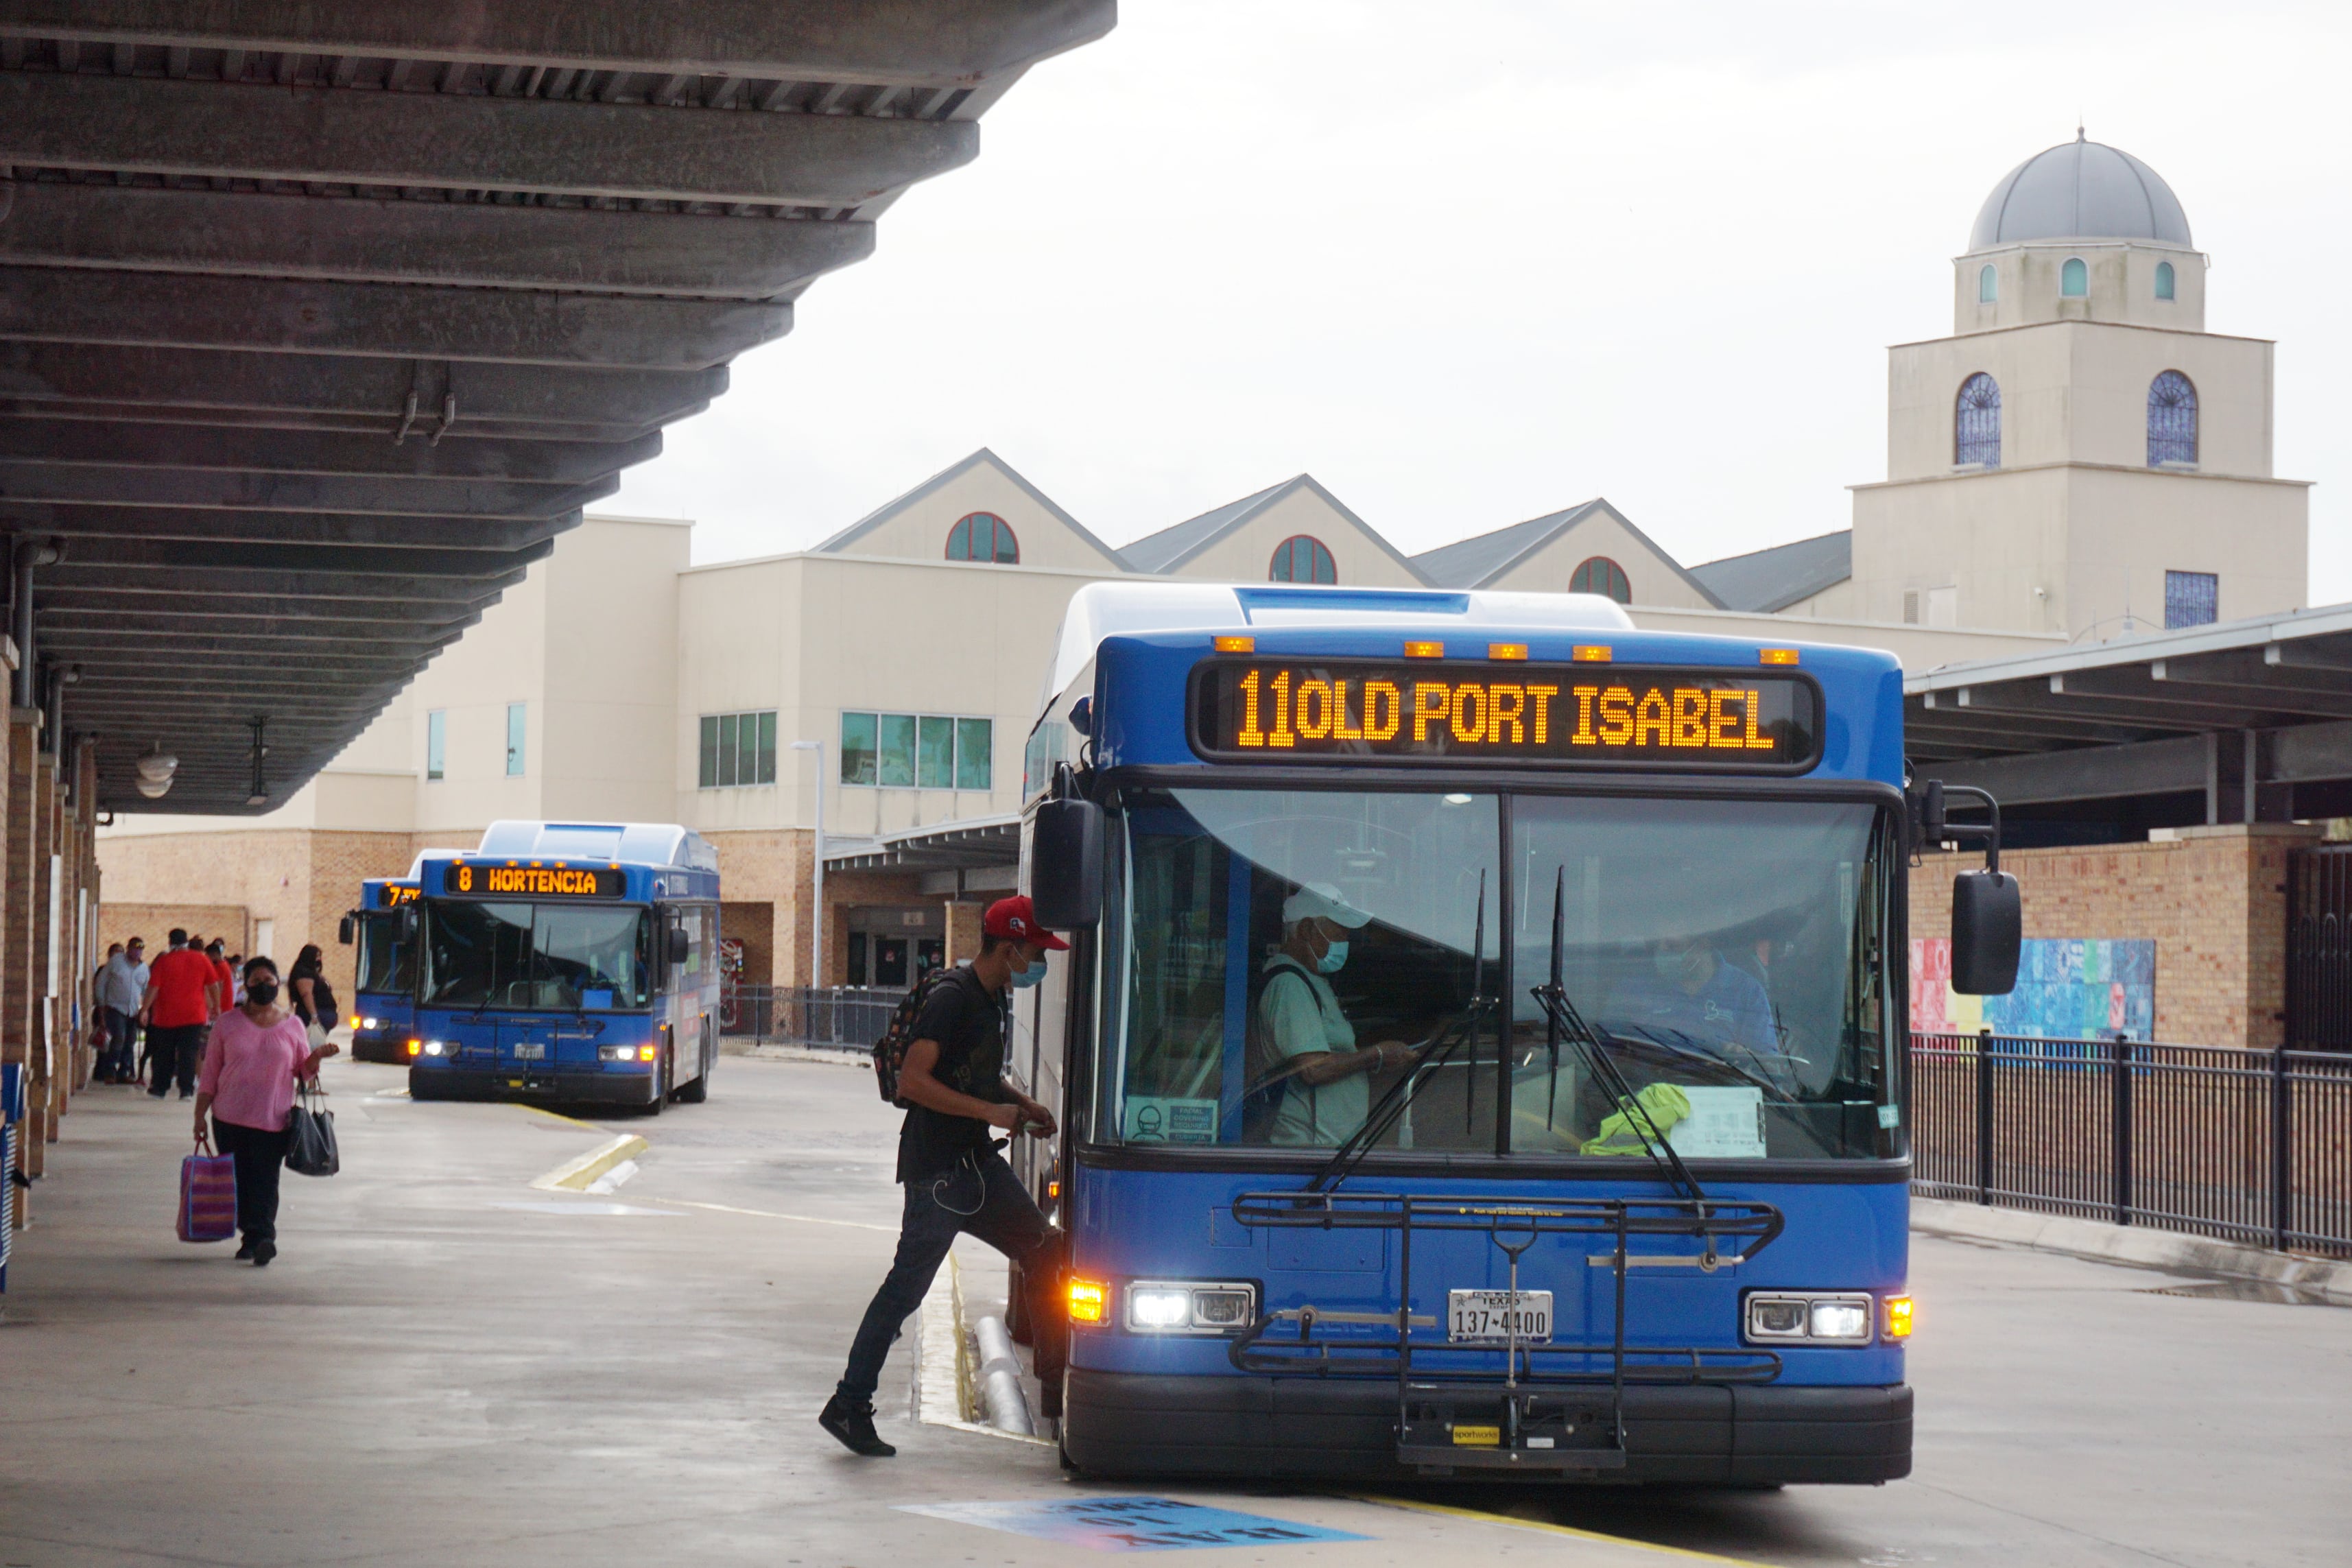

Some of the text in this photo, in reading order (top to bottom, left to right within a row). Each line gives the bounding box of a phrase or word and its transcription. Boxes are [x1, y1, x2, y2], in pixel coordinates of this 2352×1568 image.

[1414, 682, 1558, 745] PORT
[1571, 687, 1774, 750] ISABEL
[459, 866, 597, 894] 8 HORTENCIA
[390, 886, 401, 907] 7
